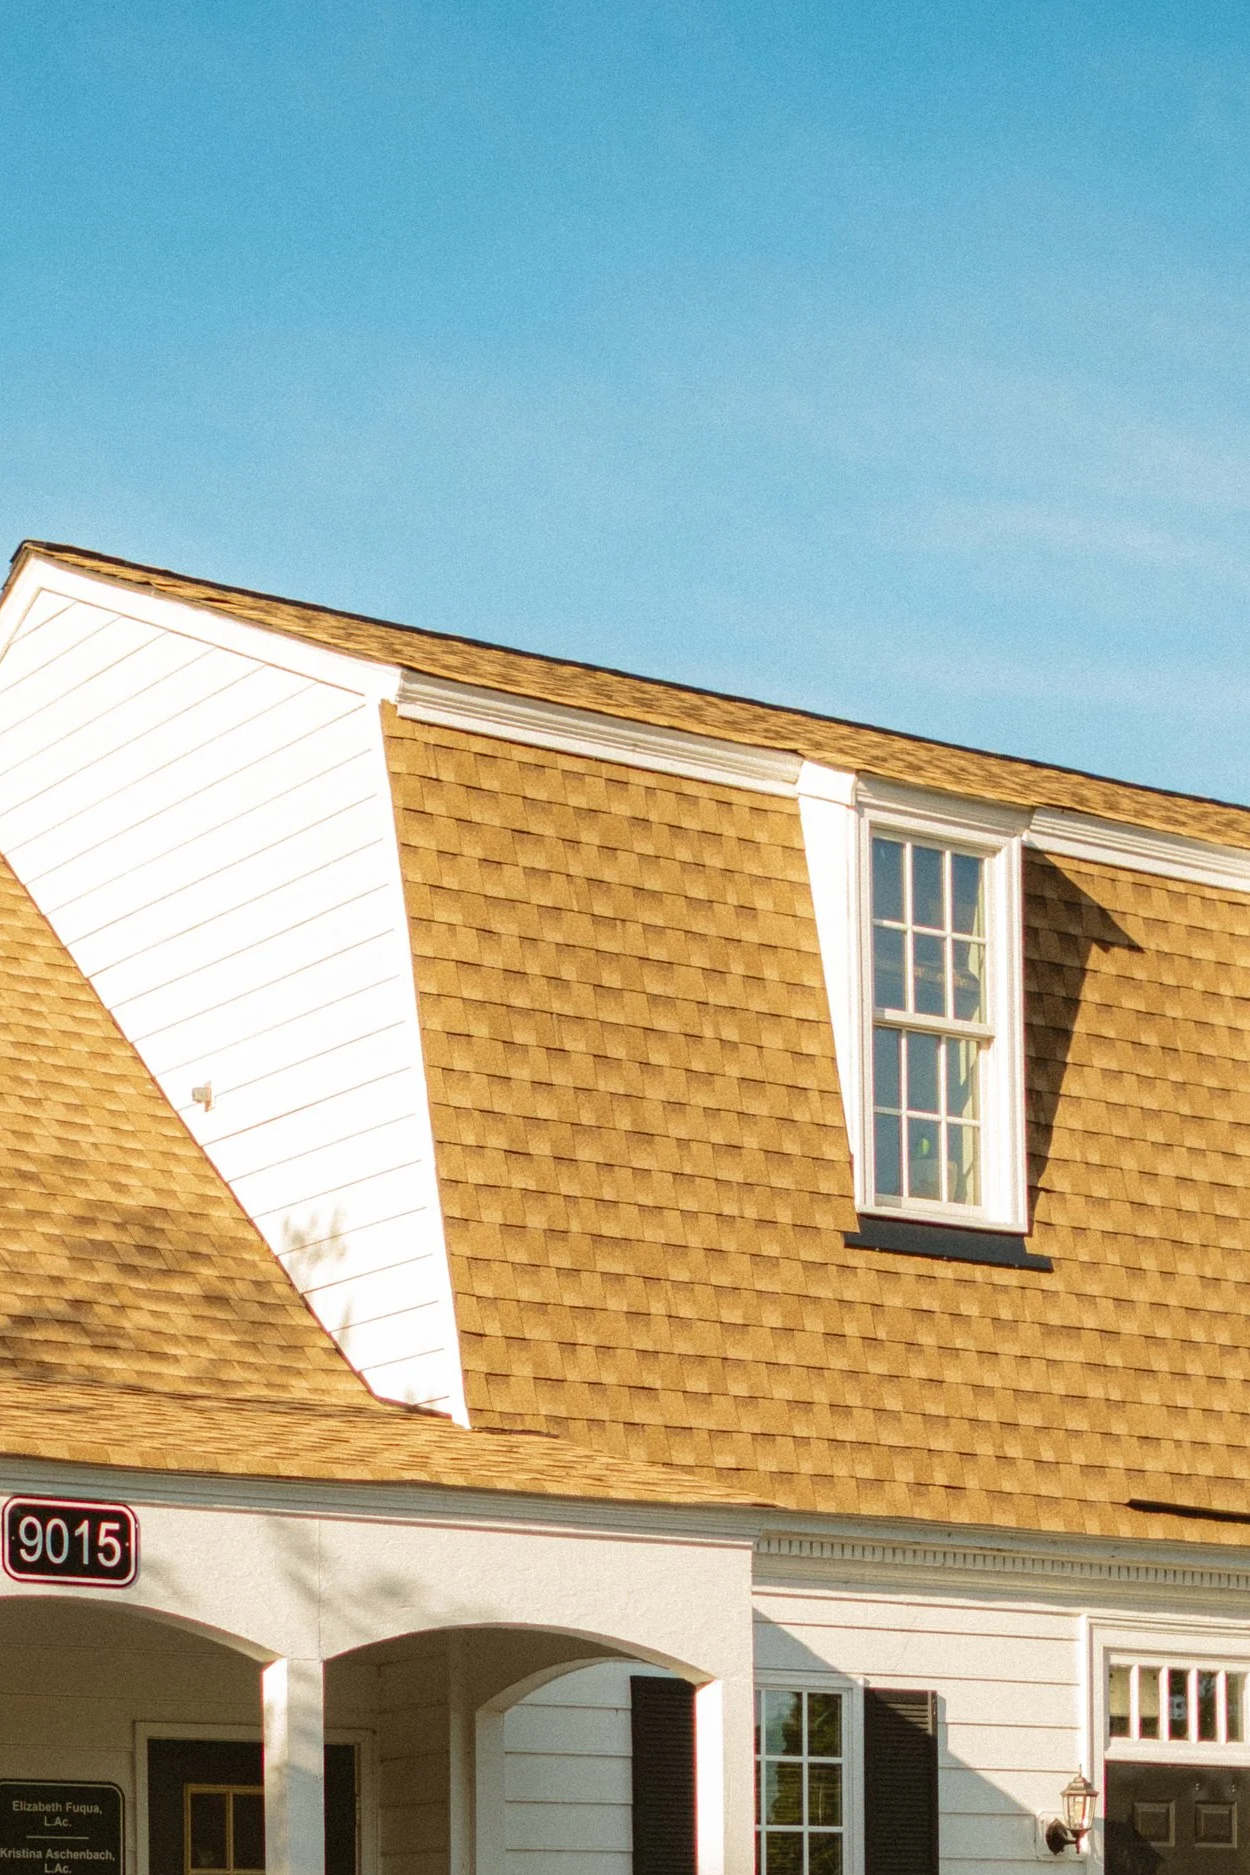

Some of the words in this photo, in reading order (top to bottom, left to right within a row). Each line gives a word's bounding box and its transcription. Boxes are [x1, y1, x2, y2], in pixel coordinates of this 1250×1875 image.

[18, 1515, 122, 1568] 9015
[12, 1800, 63, 1813] Elizabeth
[65, 1802, 103, 1816] Fuqua,
[43, 1815, 72, 1828] L.Ac.
[0, 1847, 43, 1860] Kristina
[45, 1848, 116, 1862] Aschenbach,
[43, 1863, 72, 1875] L.Ac.
